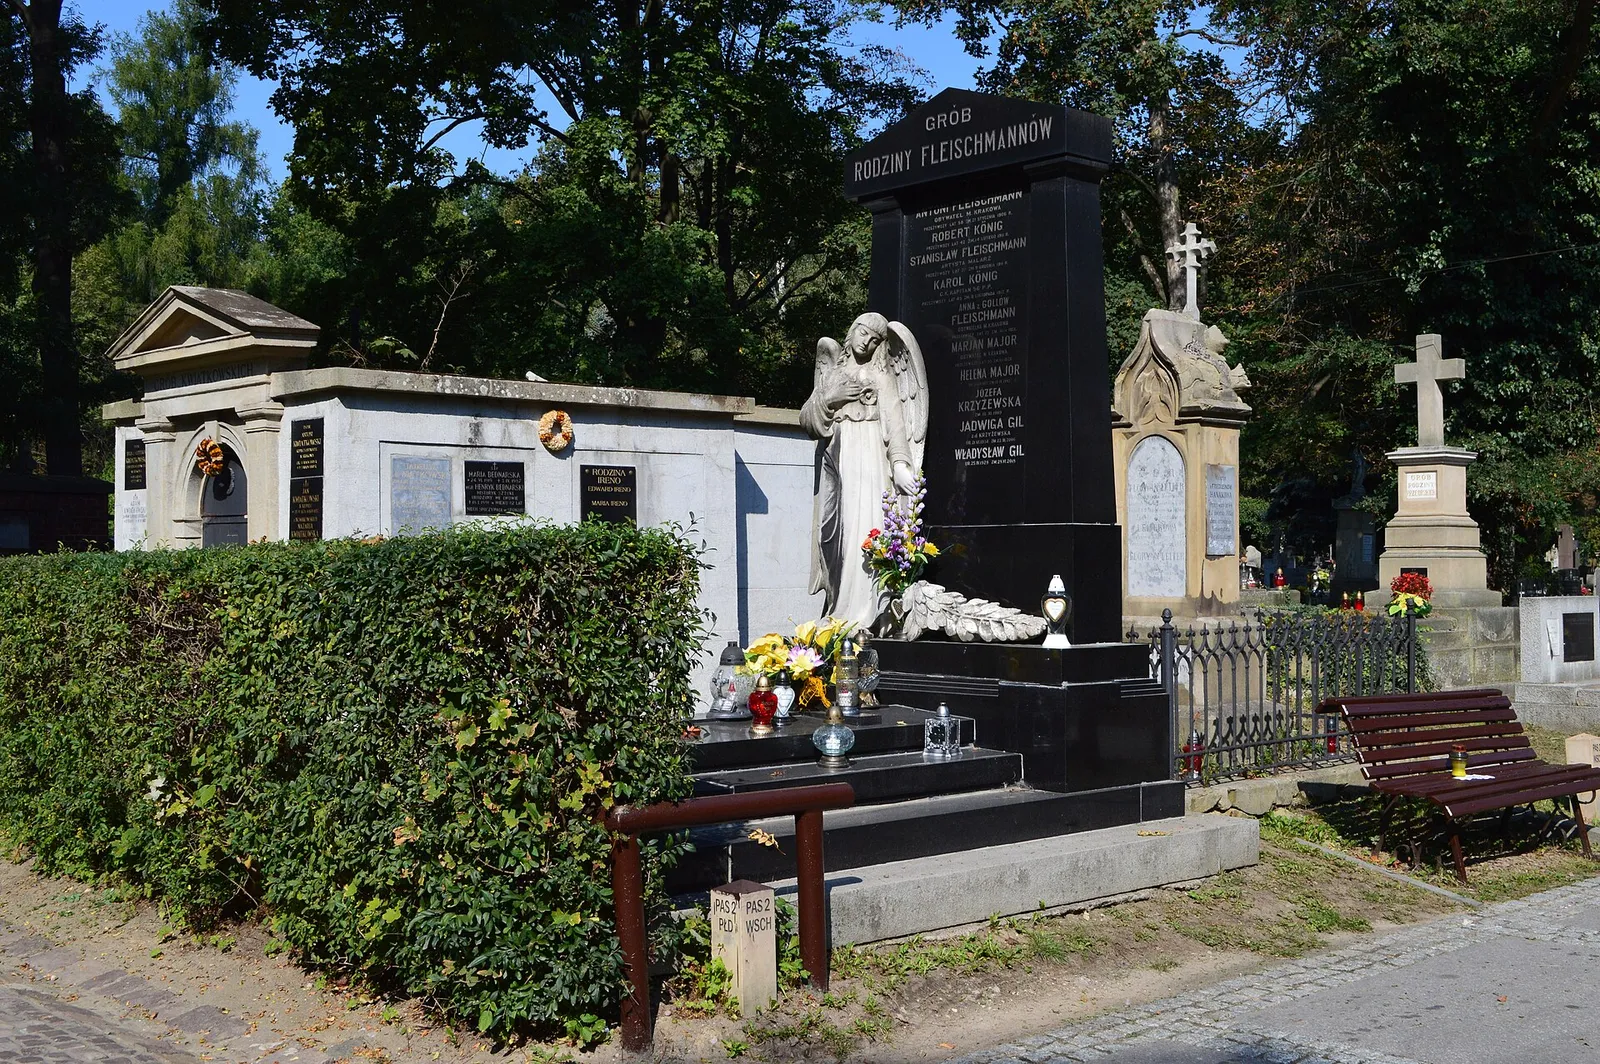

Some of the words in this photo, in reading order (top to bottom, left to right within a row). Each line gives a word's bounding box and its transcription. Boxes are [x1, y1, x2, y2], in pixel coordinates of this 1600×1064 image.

[925, 104, 972, 131] GRÓB
[854, 149, 912, 182] RODZINY
[920, 113, 1052, 167] FLEISCHMANNÓW
[932, 226, 970, 243] ROBERT
[974, 220, 1003, 235] KÖNIG
[910, 248, 958, 267] STANISŁAW
[962, 236, 1026, 258] FLEISCHMANN
[934, 276, 964, 290] KAROL
[969, 270, 998, 284] KÖNIG
[958, 302, 975, 312] ANNA
[952, 306, 1016, 326] FLEISCHMANN
[952, 338, 984, 353] MARJAN
[987, 334, 1017, 348] MAJOR
[181, 361, 254, 385] KWIATKOWSKICH
[960, 368, 986, 381] HELENA
[990, 364, 1020, 378] MAJOR
[960, 418, 1003, 432] JADWIGA
[1008, 415, 1024, 429] GIL
[955, 446, 1005, 460] WŁADYSŁAW
[1009, 444, 1024, 457] GIL
[592, 468, 626, 477] RODZINA
[598, 476, 621, 485] IRENO
[716, 898, 729, 914] PAS
[732, 901, 736, 914] 2
[746, 900, 763, 914] PAS
[765, 898, 770, 912] 2
[719, 918, 733, 933] PŁD
[746, 916, 772, 933] WSCH
